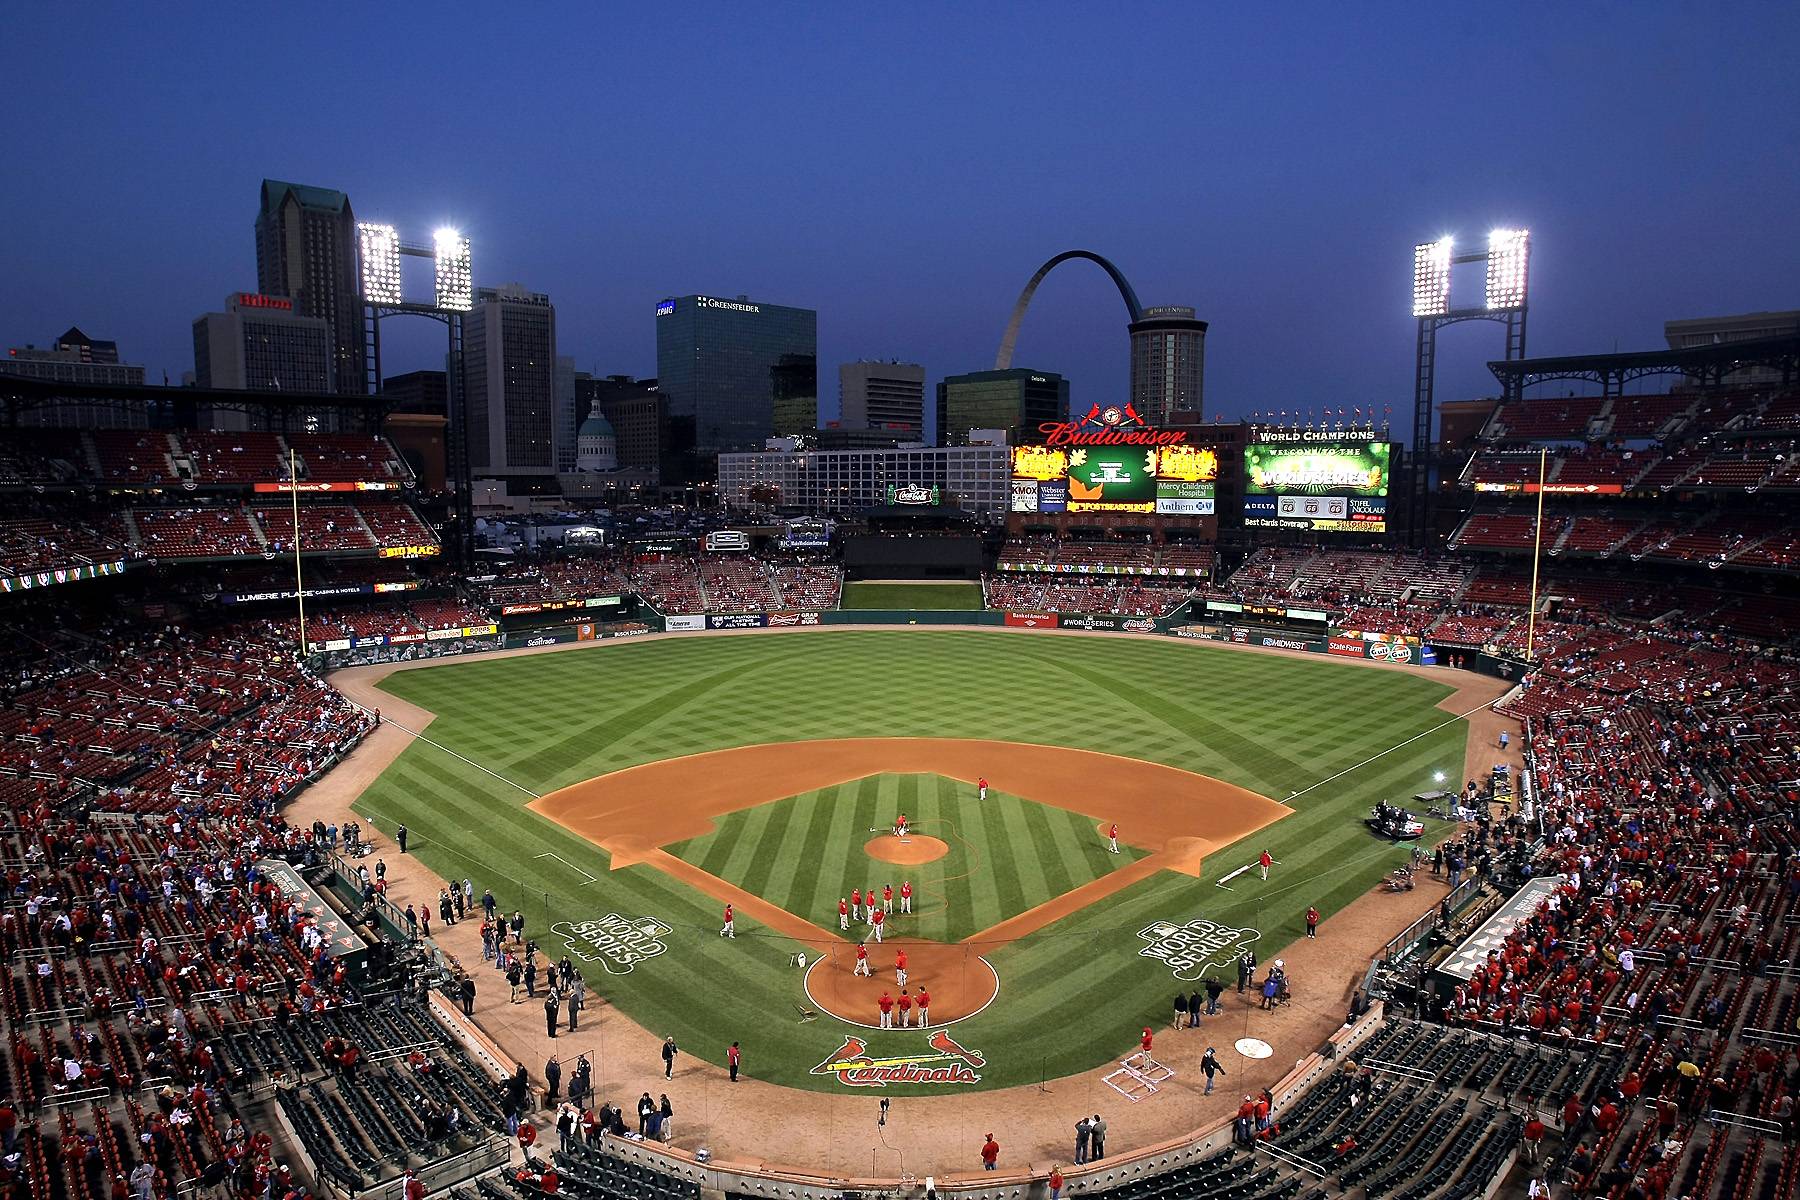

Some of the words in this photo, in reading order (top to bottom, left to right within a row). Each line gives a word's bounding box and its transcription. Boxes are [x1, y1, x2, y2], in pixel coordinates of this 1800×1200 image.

[240, 293, 292, 310] Hilton
[708, 298, 760, 313] GREENSFELDER
[656, 305, 673, 317] KPMG
[1038, 421, 1186, 446] Budweiser
[1260, 432, 1300, 442] WORLD
[1303, 431, 1375, 441] CHAMPIONS
[1261, 471, 1312, 485] WORLD
[1313, 471, 1369, 485] SERIES
[1012, 486, 1037, 495] KMOX
[1041, 486, 1065, 494] Webster
[1158, 483, 1180, 491] Mercy
[1181, 482, 1214, 490] Children's
[1179, 490, 1206, 498] Hospital
[1086, 503, 1133, 511] POSTSEASON
[1158, 501, 1194, 511] Anthem
[1352, 505, 1385, 513] NICOLAUS
[1260, 519, 1278, 527] Cards
[1279, 520, 1309, 528] Coverage
[386, 547, 405, 557] BIG
[407, 545, 433, 555] MAC
[1063, 619, 1115, 628] #WORLDSERIES
[1274, 639, 1305, 651] MIDWEST
[1329, 642, 1345, 651] State
[1345, 644, 1362, 653] Farm
[1371, 647, 1388, 656] Gulf
[1391, 650, 1409, 658] Gulf
[598, 916, 662, 954] WORLD
[1142, 922, 1215, 958] WORLD
[571, 922, 641, 964] SERIES
[1168, 928, 1241, 970] SERIES
[837, 1057, 982, 1087] Cardinals
